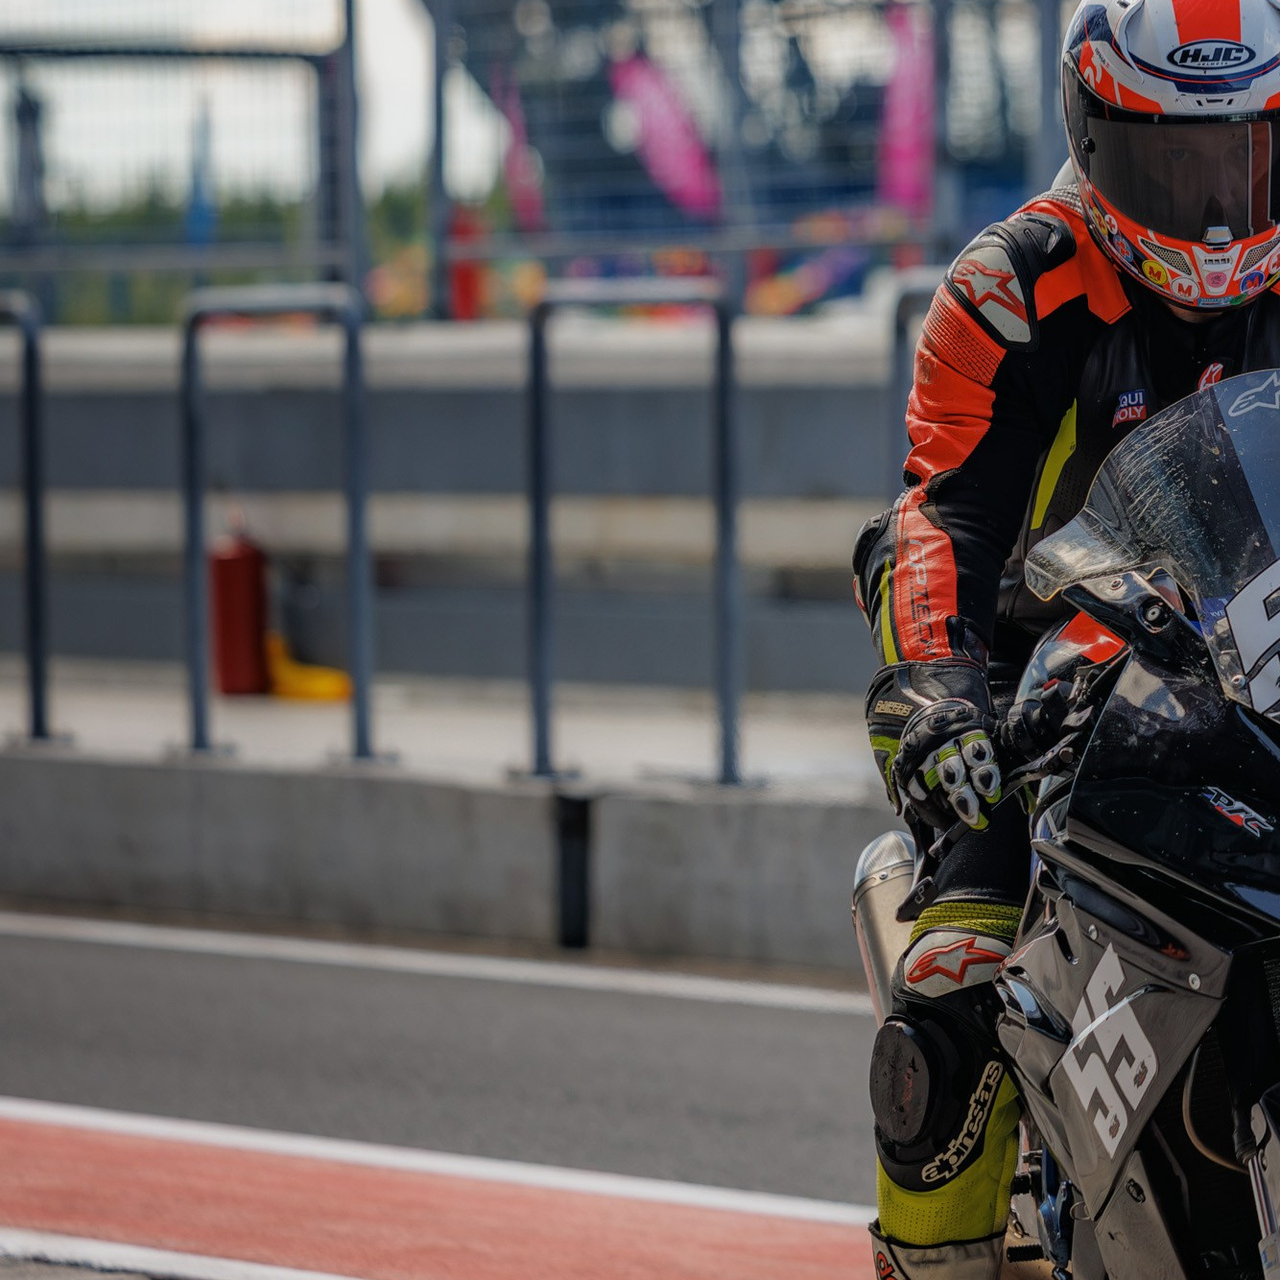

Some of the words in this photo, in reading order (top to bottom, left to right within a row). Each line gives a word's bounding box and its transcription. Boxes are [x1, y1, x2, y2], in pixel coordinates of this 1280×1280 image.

[1179, 47, 1245, 64] HJC
[1119, 391, 1144, 408] QUI
[921, 1060, 1004, 1183] alpinestars
